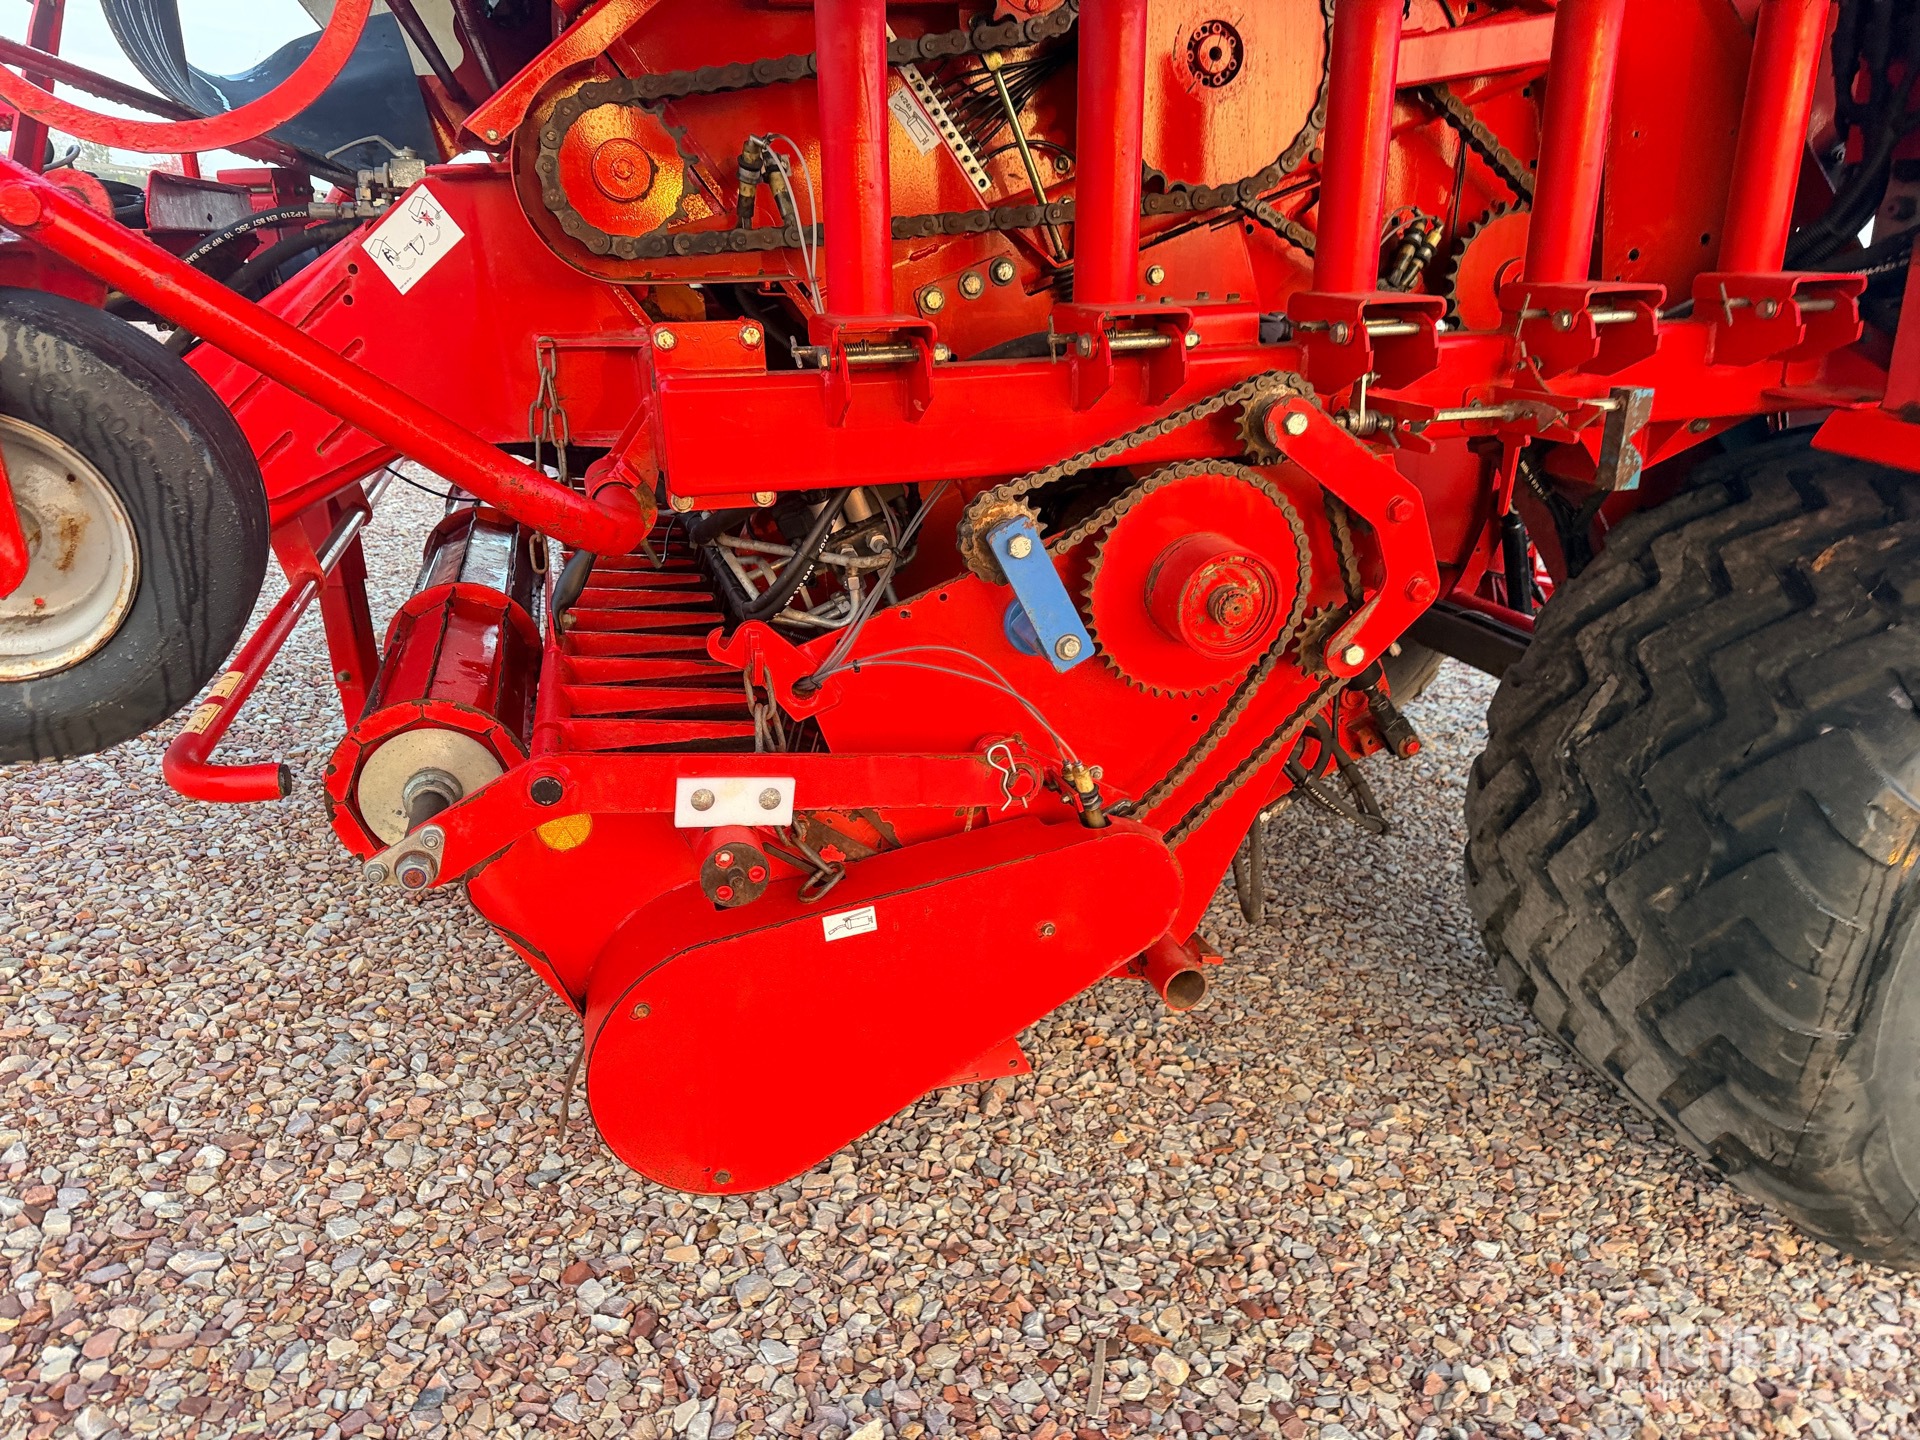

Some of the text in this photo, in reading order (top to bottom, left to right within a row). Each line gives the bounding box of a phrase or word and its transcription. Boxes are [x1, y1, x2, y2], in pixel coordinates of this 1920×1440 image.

[266, 214, 278, 223] EN
[281, 210, 307, 219] KP210
[252, 217, 266, 227] 857
[234, 223, 251, 234] 2SC
[224, 231, 234, 239] 10
[212, 237, 226, 247] WP
[199, 244, 213, 254] 330
